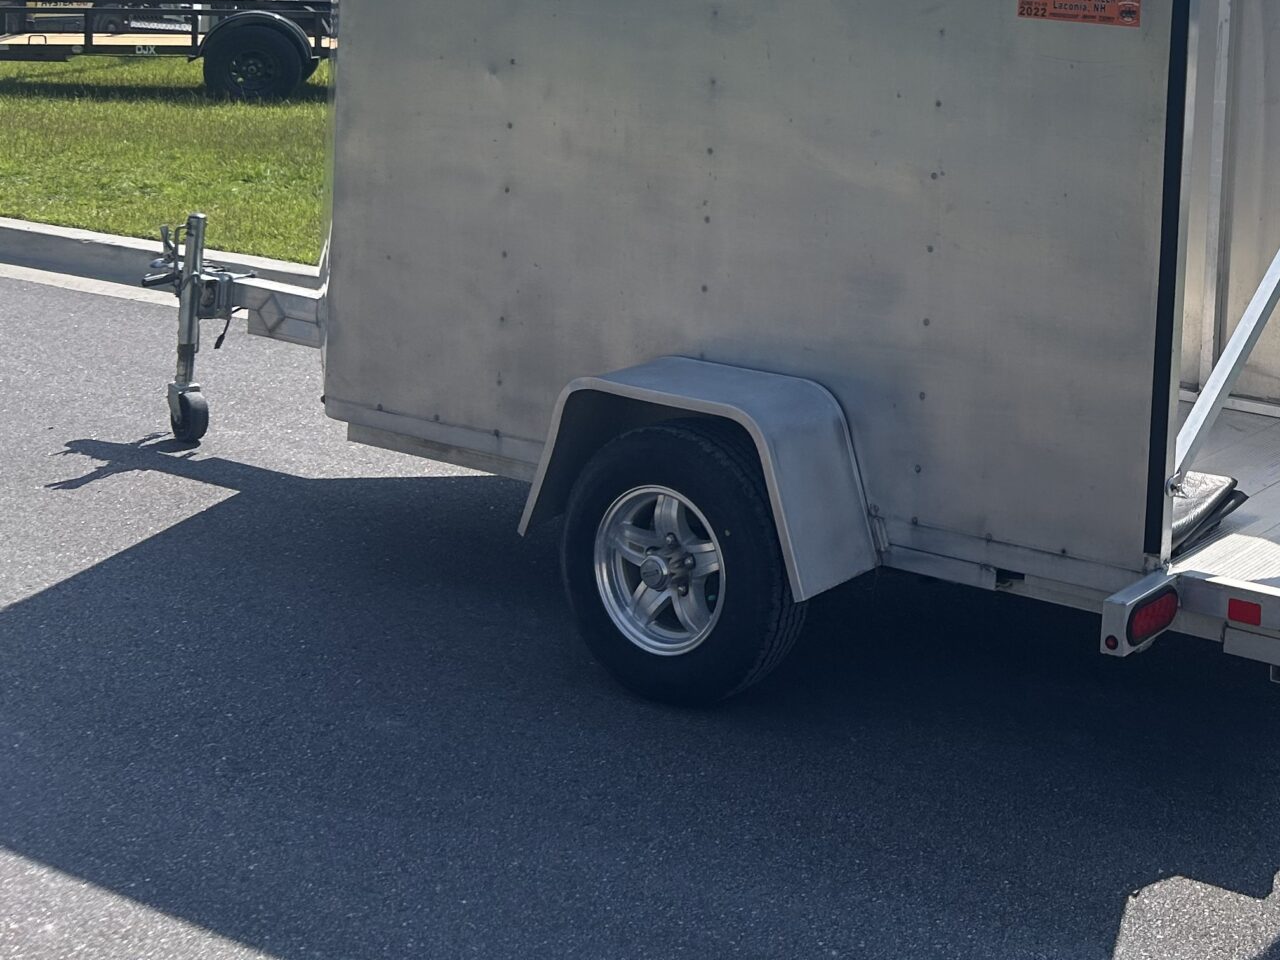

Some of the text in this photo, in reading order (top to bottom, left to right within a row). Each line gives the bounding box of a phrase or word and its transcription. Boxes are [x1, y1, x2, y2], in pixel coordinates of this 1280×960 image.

[1018, 6, 1047, 17] 2022
[1093, 3, 1106, 13] NH
[135, 45, 157, 55] DJX
